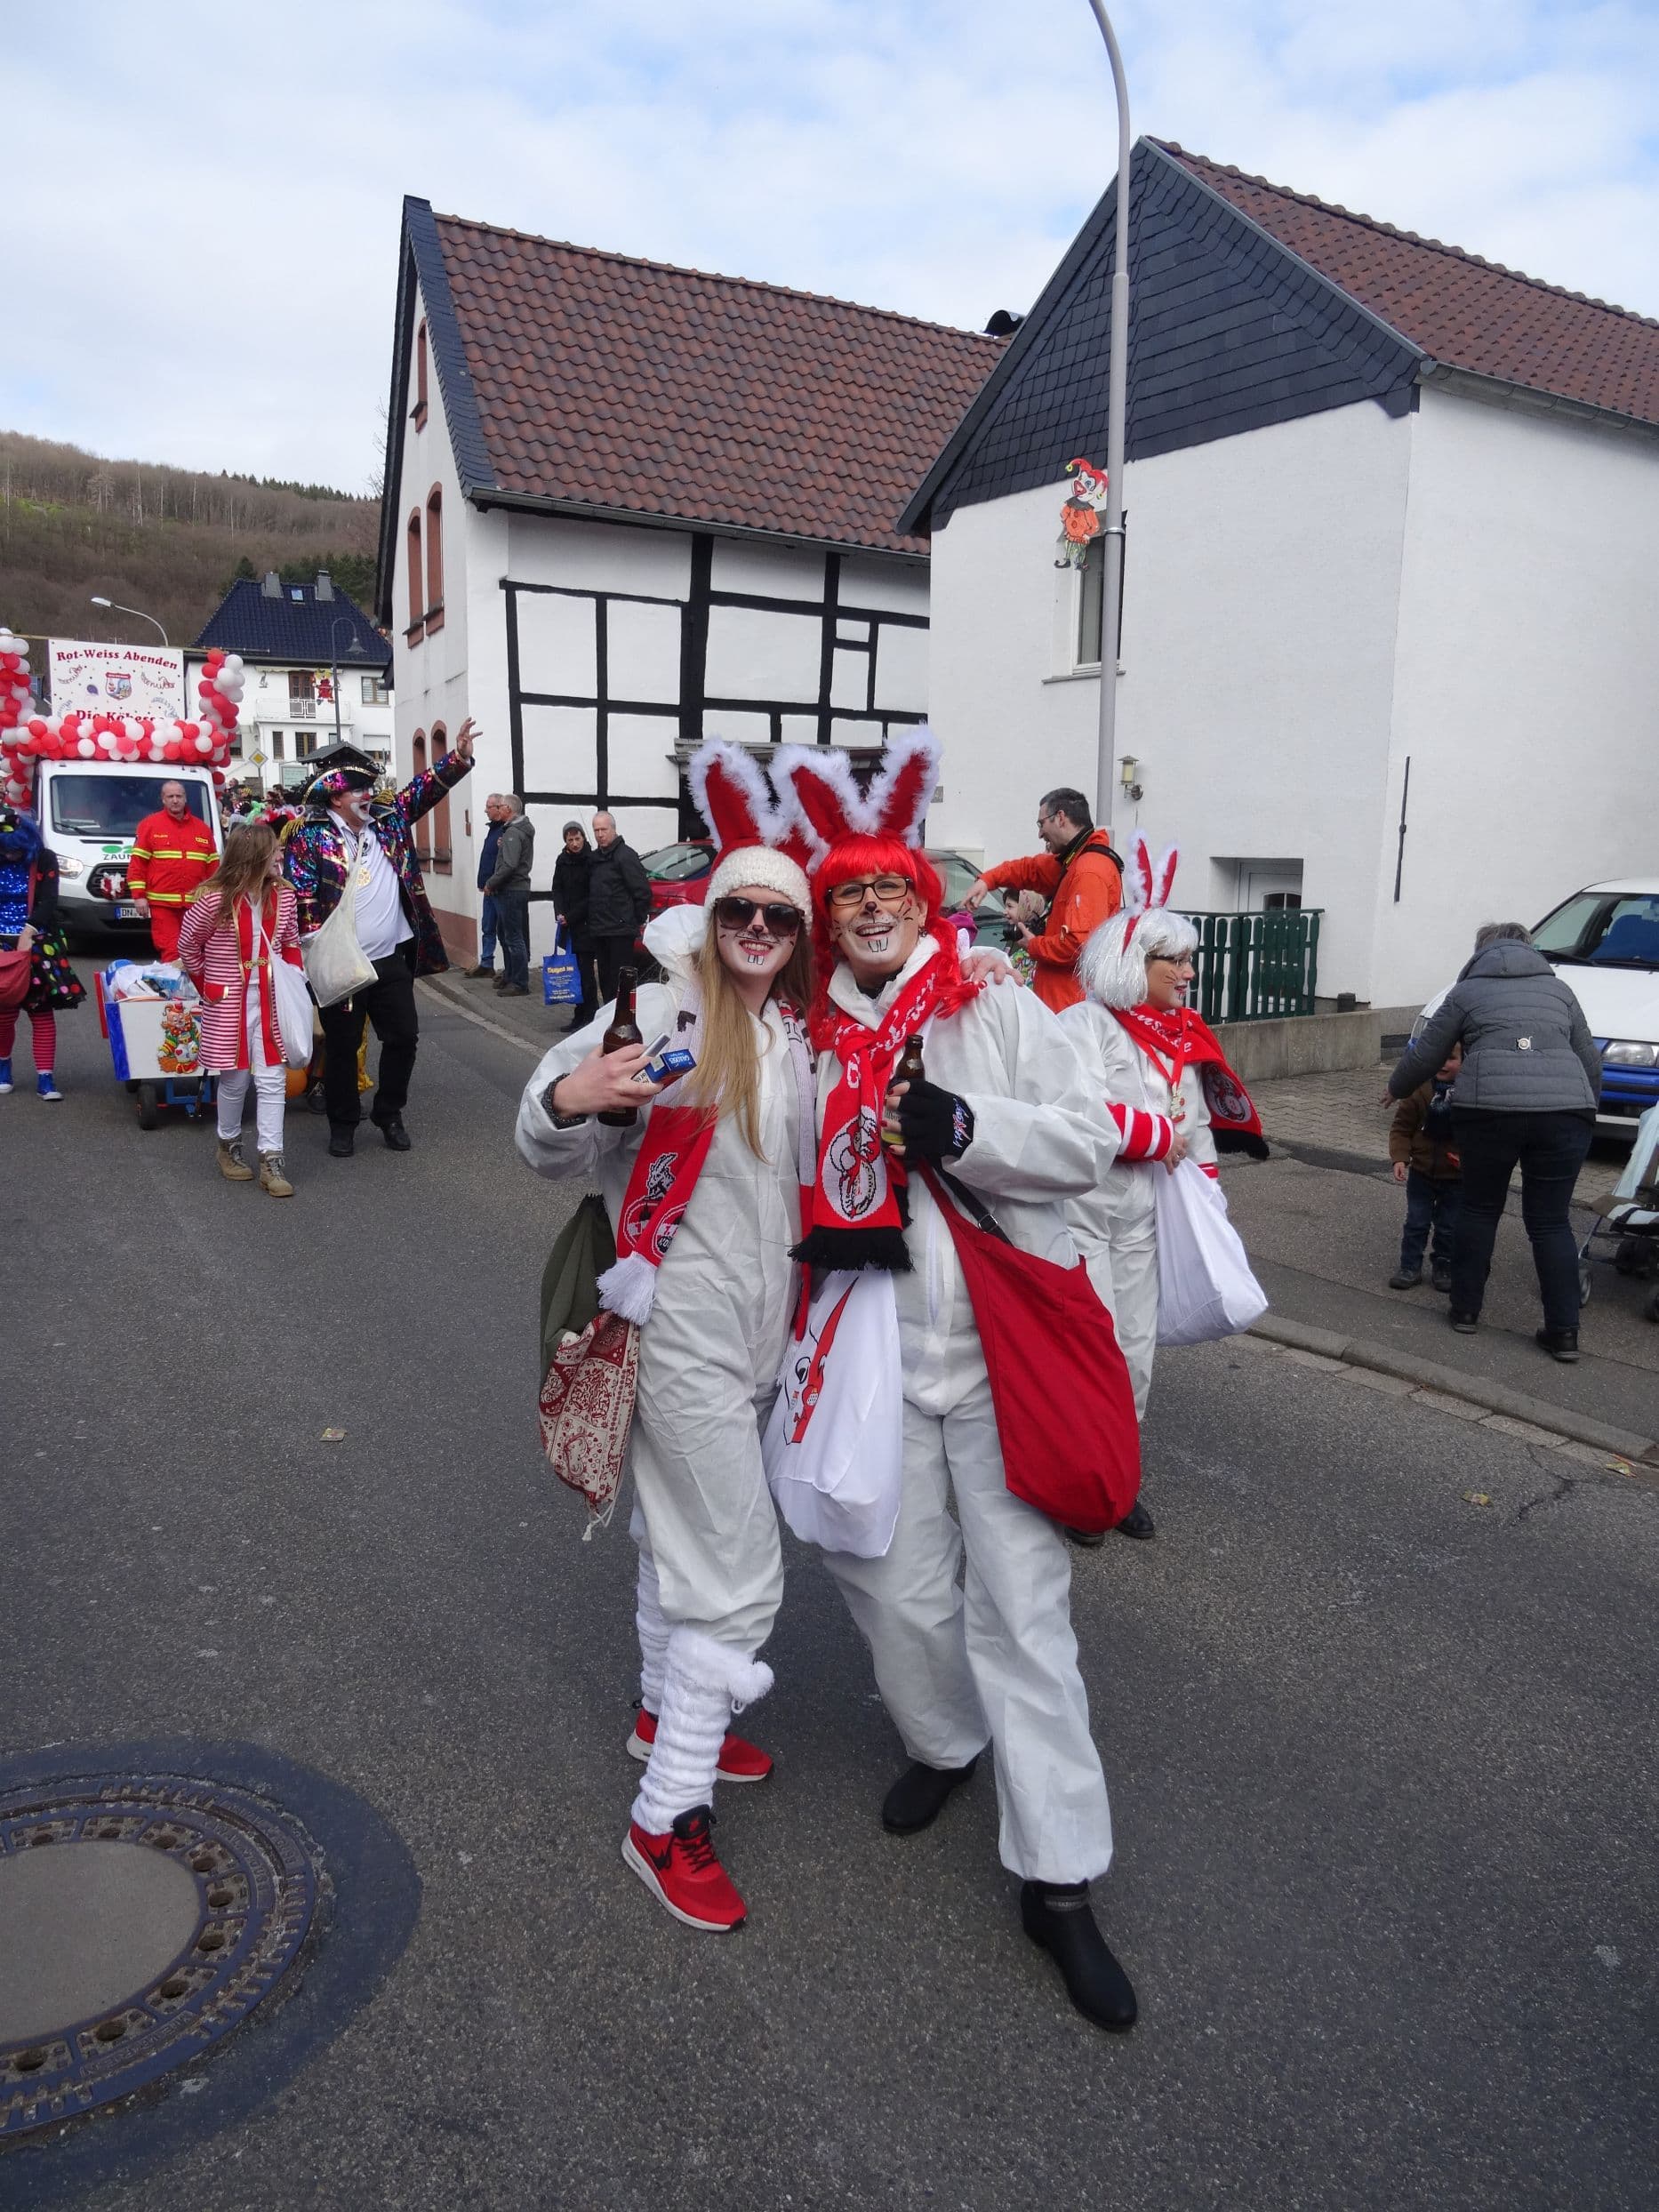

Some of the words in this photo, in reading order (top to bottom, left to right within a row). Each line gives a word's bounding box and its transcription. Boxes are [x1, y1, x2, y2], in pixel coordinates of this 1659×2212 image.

[57, 649, 120, 661] Rot-Weiss
[123, 651, 178, 669] Abenden
[76, 709, 100, 720] Die
